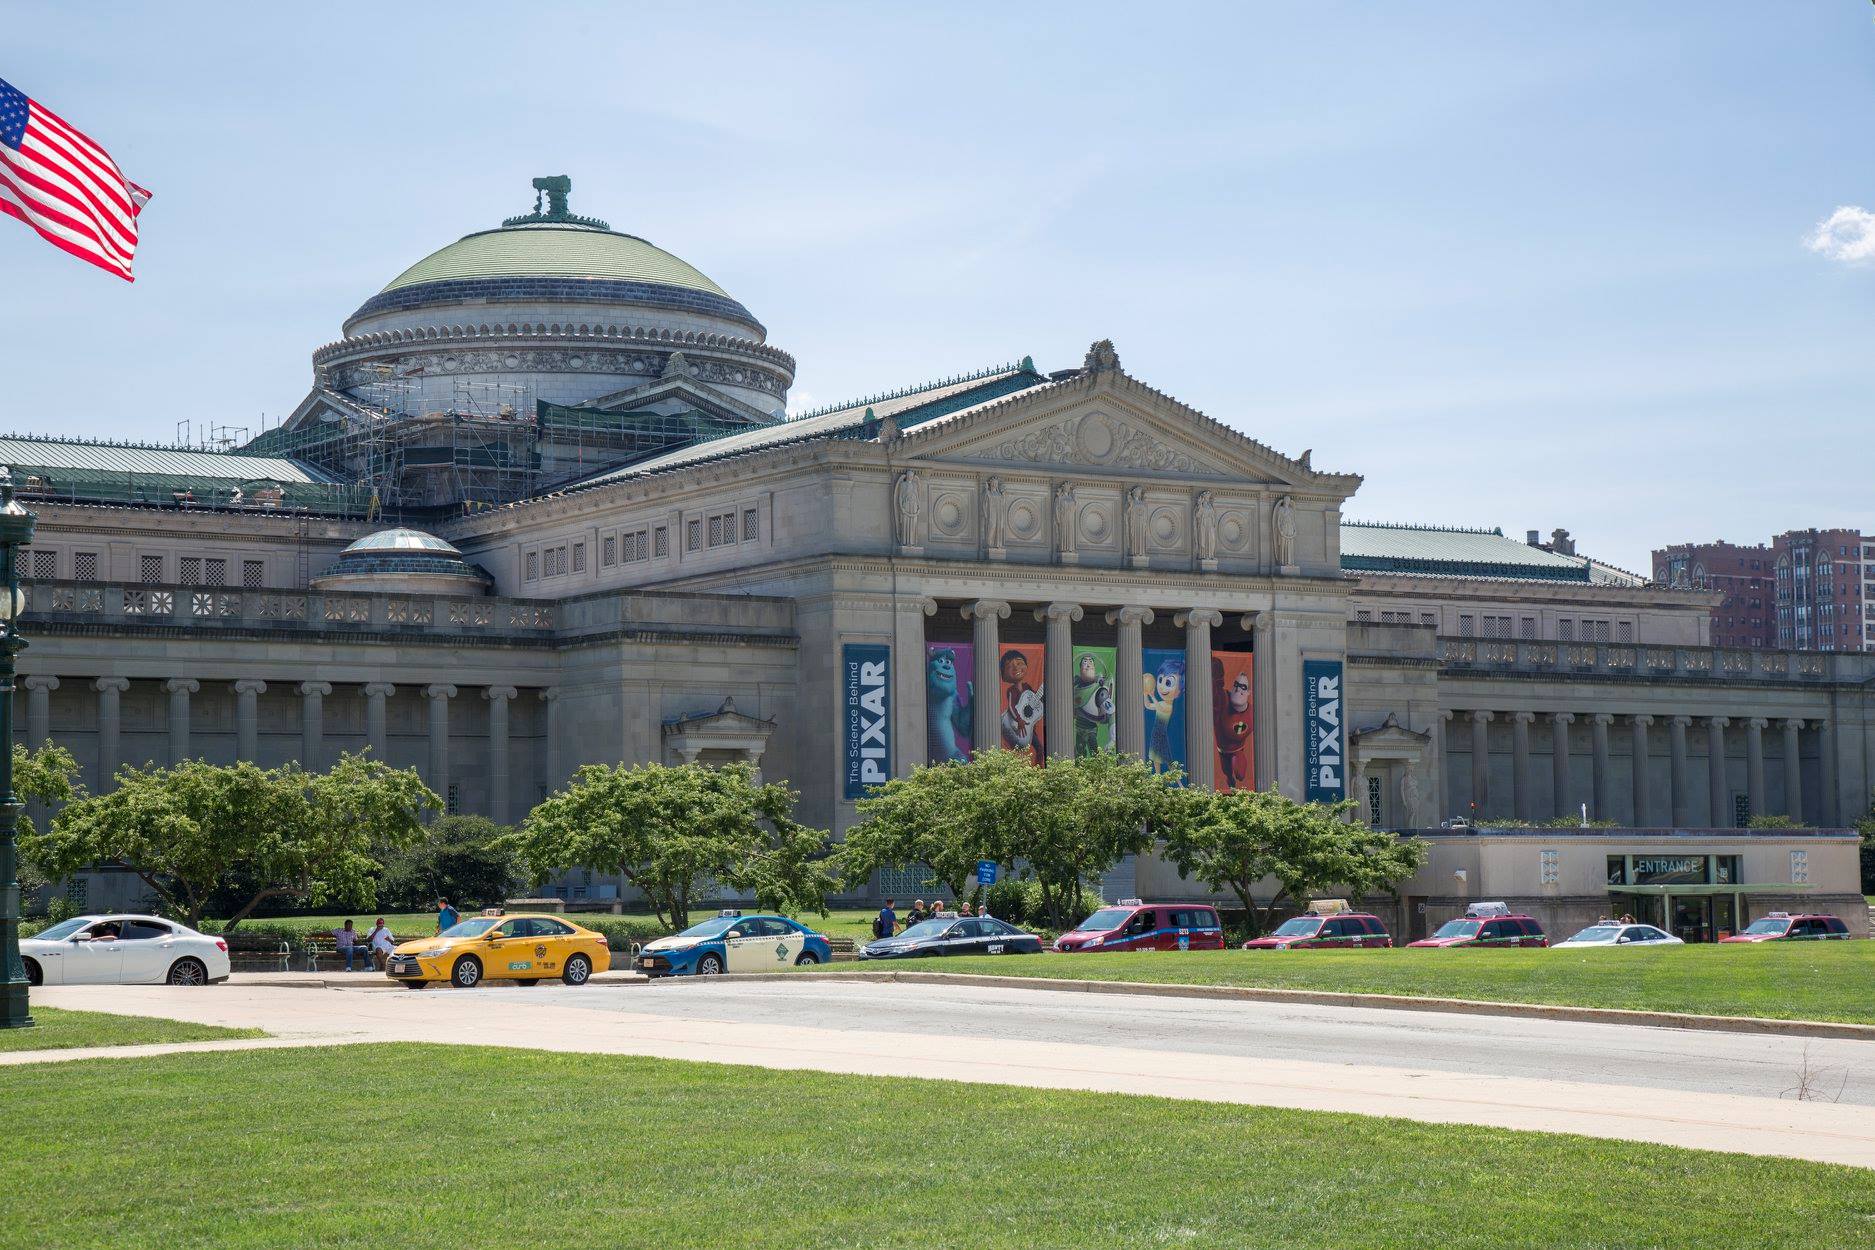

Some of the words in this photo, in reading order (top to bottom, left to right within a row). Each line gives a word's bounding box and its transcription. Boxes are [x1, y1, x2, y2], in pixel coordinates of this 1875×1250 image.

[849, 662, 859, 705] Behind
[1308, 676, 1317, 717] Behind
[849, 709, 859, 758] Science
[860, 660, 886, 783] PIXAR
[1309, 720, 1318, 765] Science
[1318, 675, 1340, 788] PIXAR
[849, 761, 859, 784] The
[1309, 768, 1318, 789] The
[1639, 860, 1698, 873] ENTRANCE
